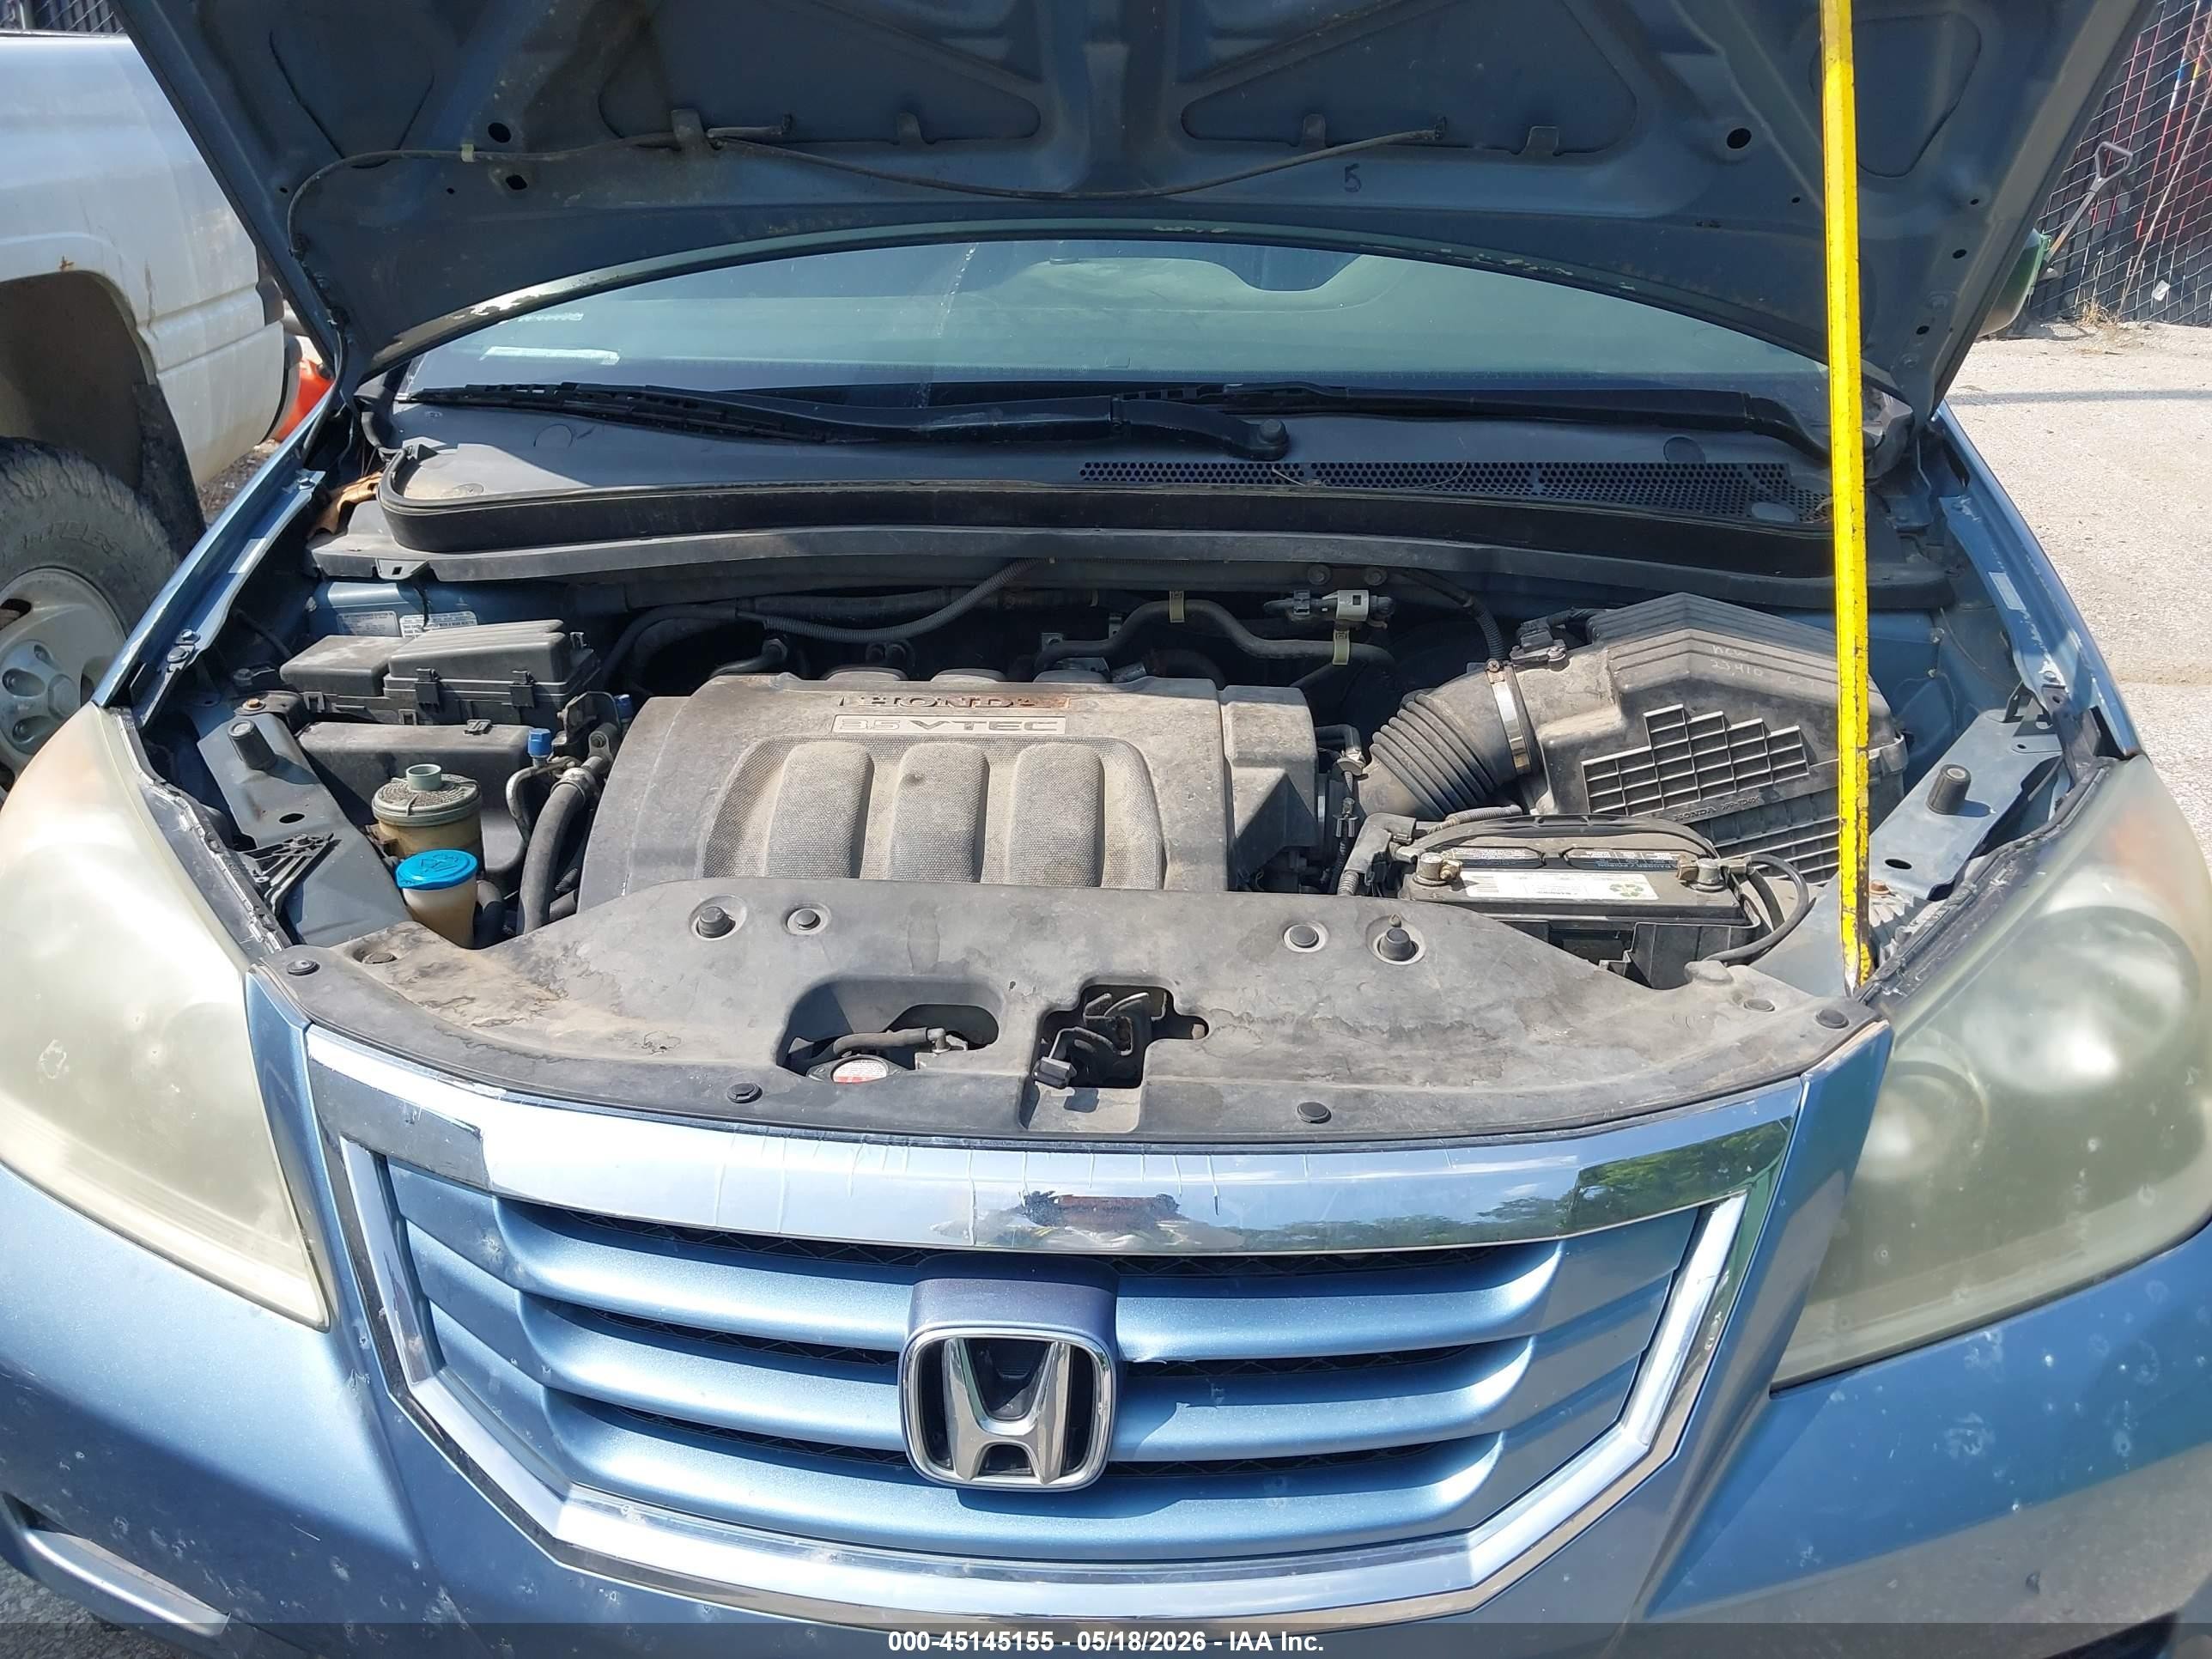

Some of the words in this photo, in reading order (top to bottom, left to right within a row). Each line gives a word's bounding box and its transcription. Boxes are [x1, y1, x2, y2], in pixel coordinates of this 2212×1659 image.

[1343, 162, 1362, 193] 5
[859, 695, 1053, 708] HONDA
[909, 720, 1058, 731] VTEC
[1674, 805, 1717, 822] HONDA
